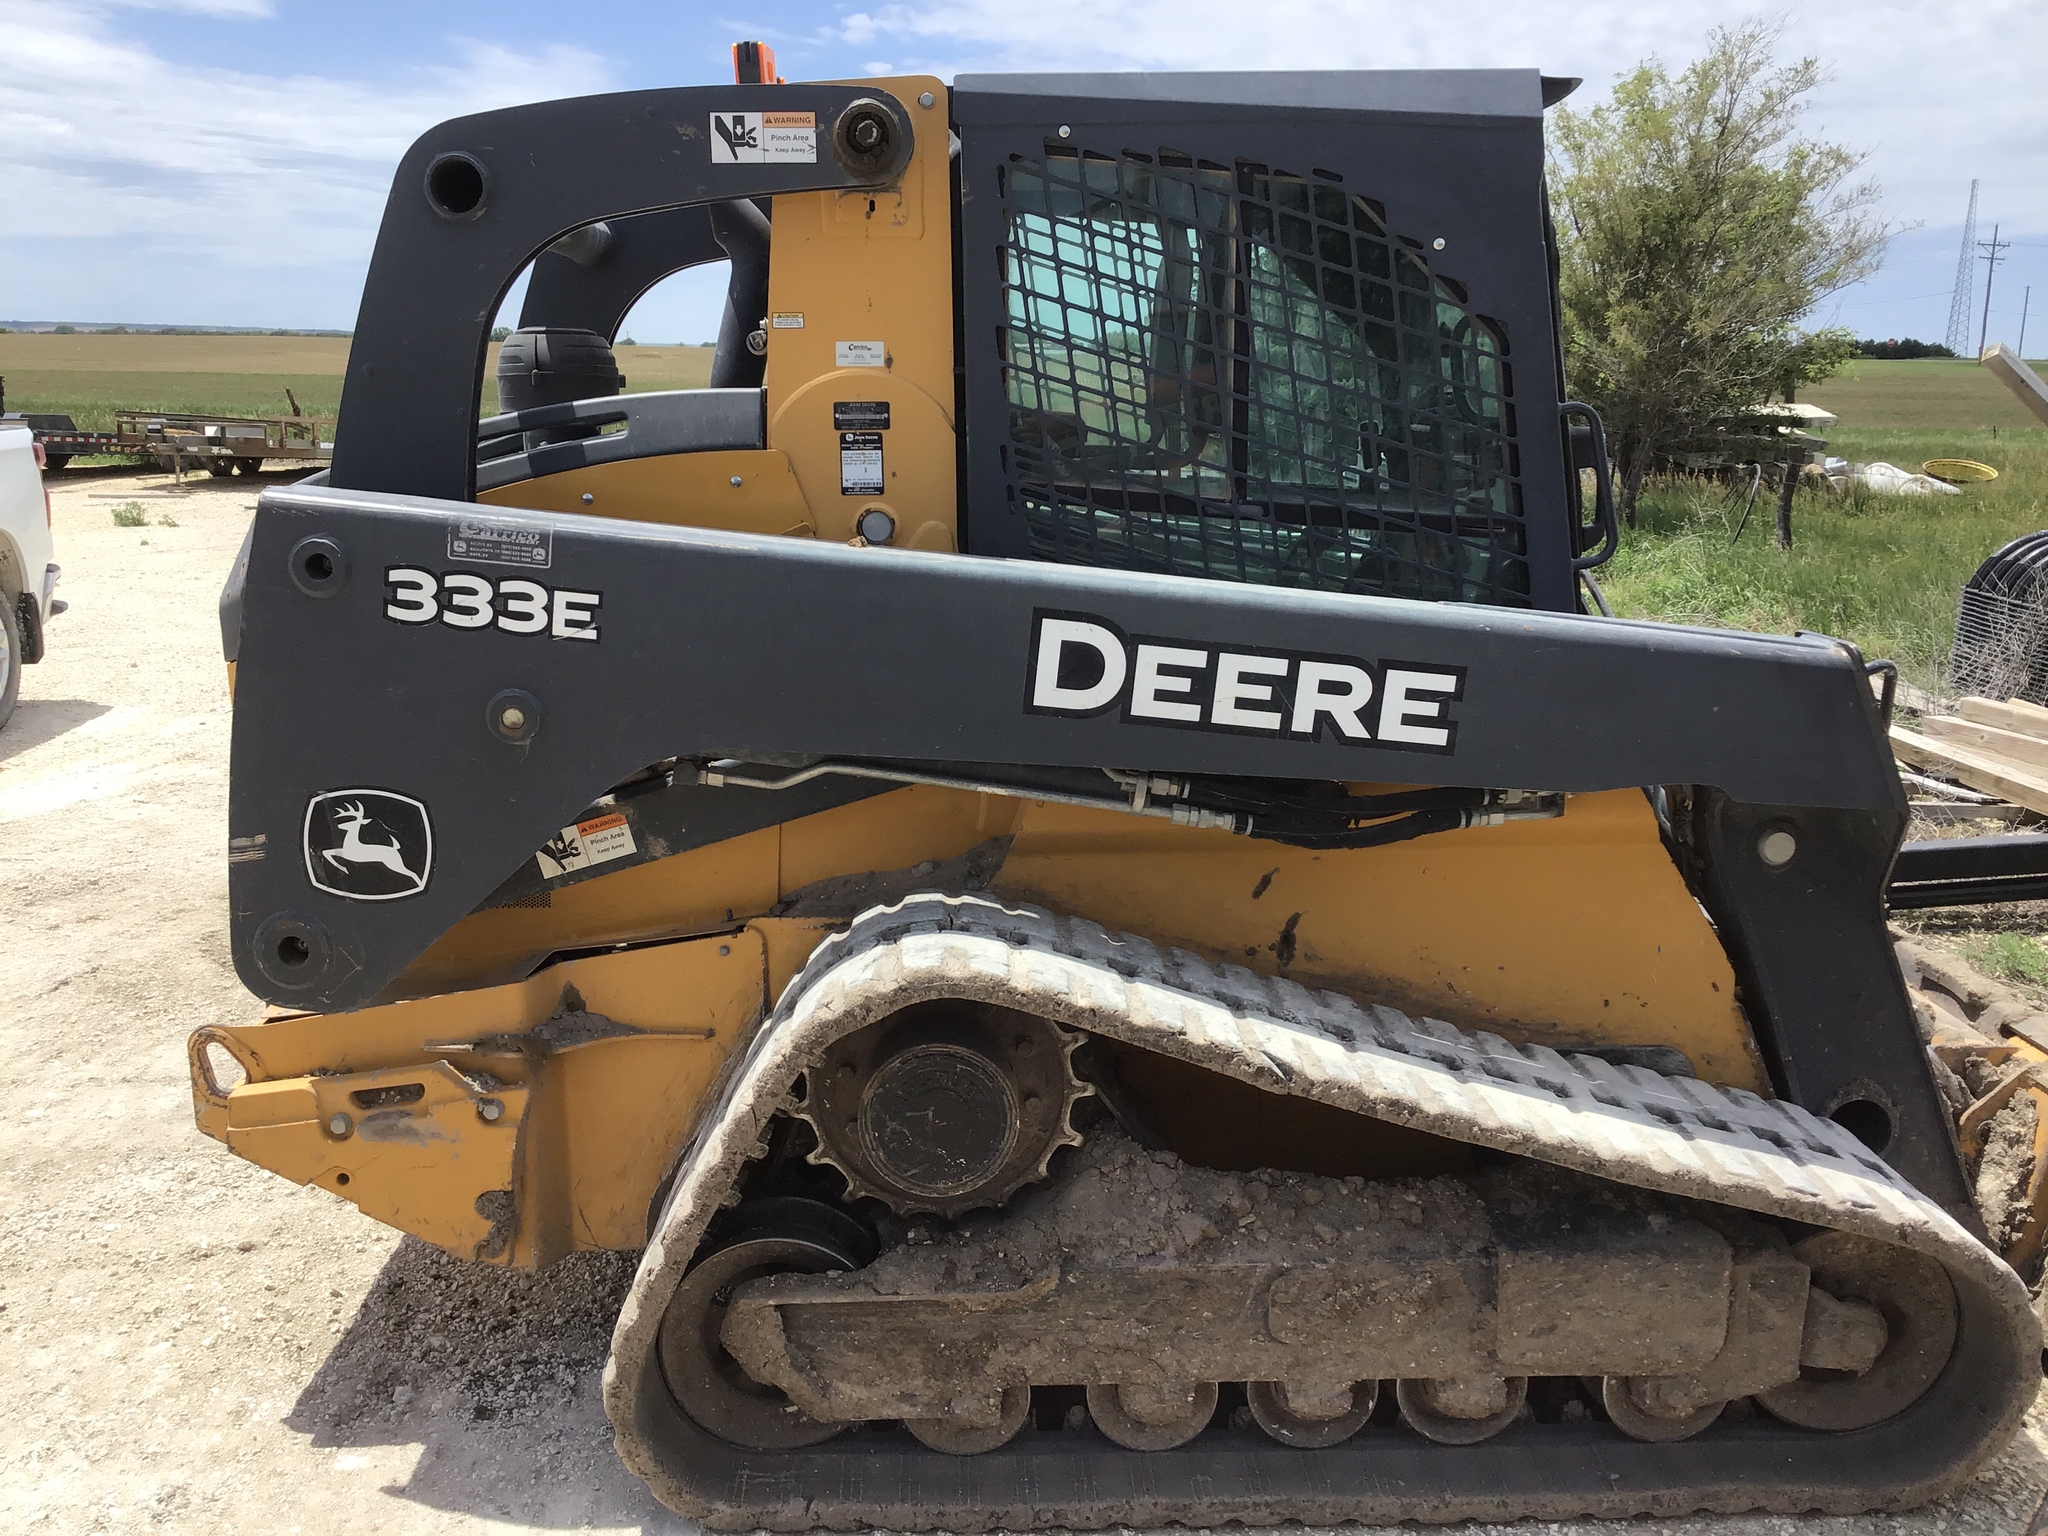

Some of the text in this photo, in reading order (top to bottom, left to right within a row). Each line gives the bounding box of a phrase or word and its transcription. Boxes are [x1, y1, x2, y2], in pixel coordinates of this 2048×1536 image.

[387, 568, 600, 640] 333E
[1032, 617, 1458, 746] DEERE
[588, 815, 622, 830] WARNING
[590, 831, 625, 846] Pinch Area
[597, 842, 625, 855] Keep Away
